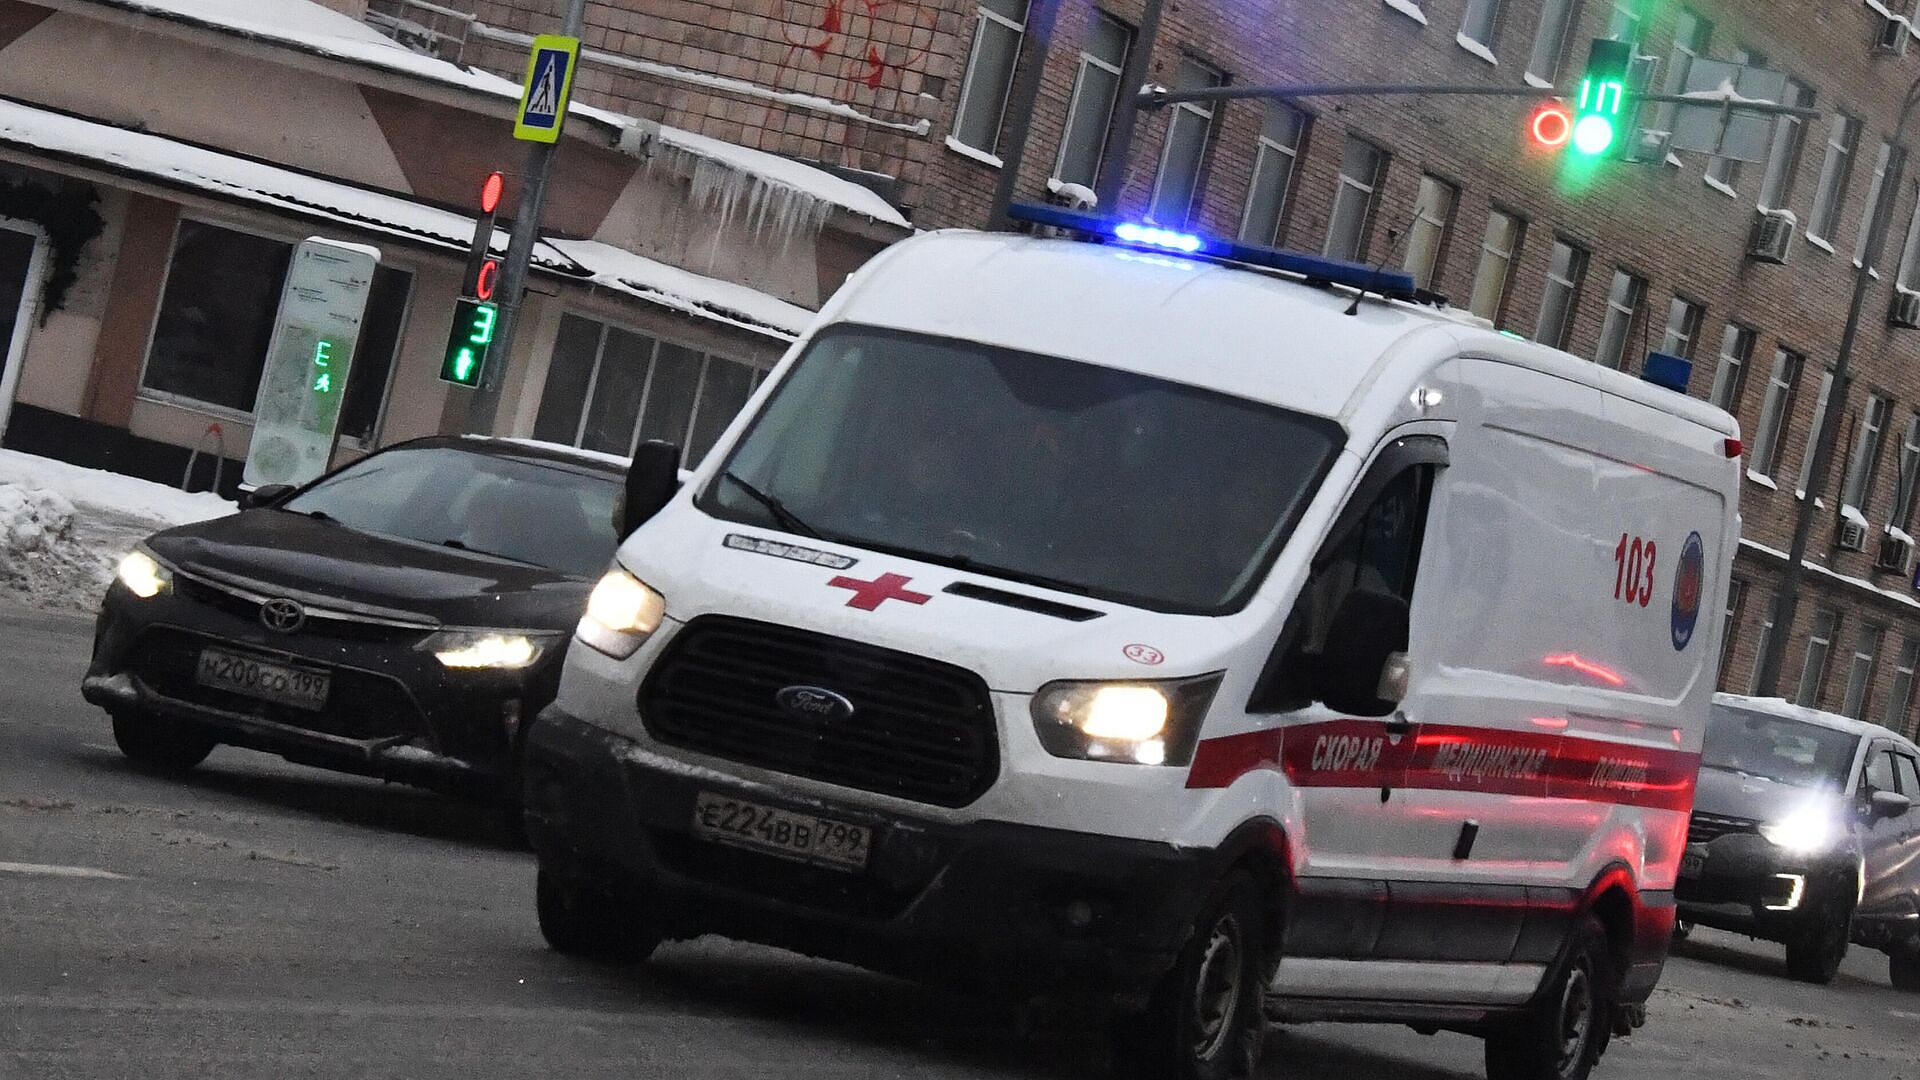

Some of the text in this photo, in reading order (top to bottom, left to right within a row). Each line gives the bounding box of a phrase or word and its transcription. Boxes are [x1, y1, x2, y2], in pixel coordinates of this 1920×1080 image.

[1615, 533, 1656, 608] 103
[1130, 646, 1158, 665] 33
[791, 690, 835, 713] Ford
[1311, 735, 1384, 771] СКОРАЯ
[817, 821, 863, 850] 799
